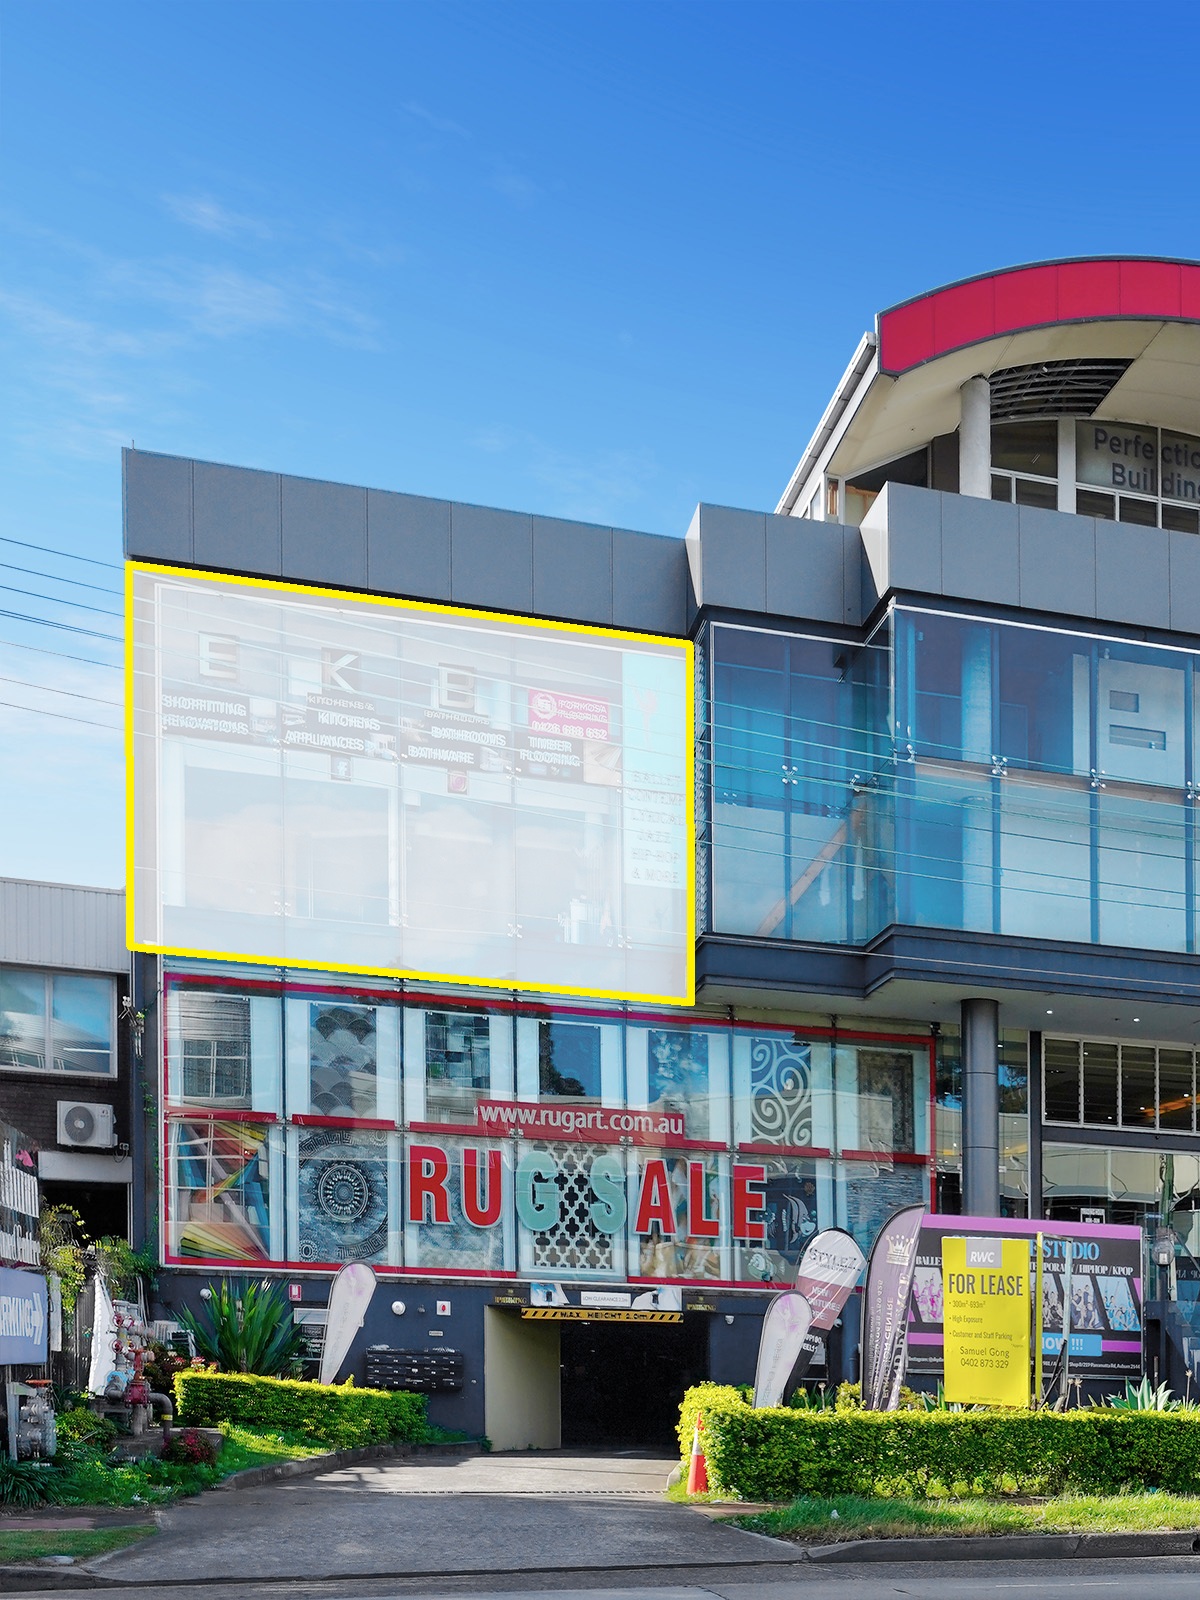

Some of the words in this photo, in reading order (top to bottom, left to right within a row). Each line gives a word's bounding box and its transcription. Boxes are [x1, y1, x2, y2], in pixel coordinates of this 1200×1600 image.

[479, 1103, 683, 1135] www.rugart.com.au
[408, 1143, 560, 1234] RUG
[970, 1251, 995, 1263] RWC
[915, 1256, 942, 1266] BALLE
[1079, 1264, 1108, 1275] HIPHOP
[1112, 1266, 1134, 1276] KPOP
[949, 1273, 976, 1295] FOR
[981, 1274, 1024, 1297] LEASE
[952, 1315, 962, 1323] High
[963, 1315, 983, 1323] Exposure
[952, 1330, 973, 1338] Customer
[995, 1332, 1013, 1341] Parking
[960, 1346, 987, 1356] Samuel
[989, 1347, 1010, 1358] Gong
[960, 1358, 979, 1367] 0402
[980, 1359, 994, 1368] 873
[995, 1360, 1009, 1368] 329
